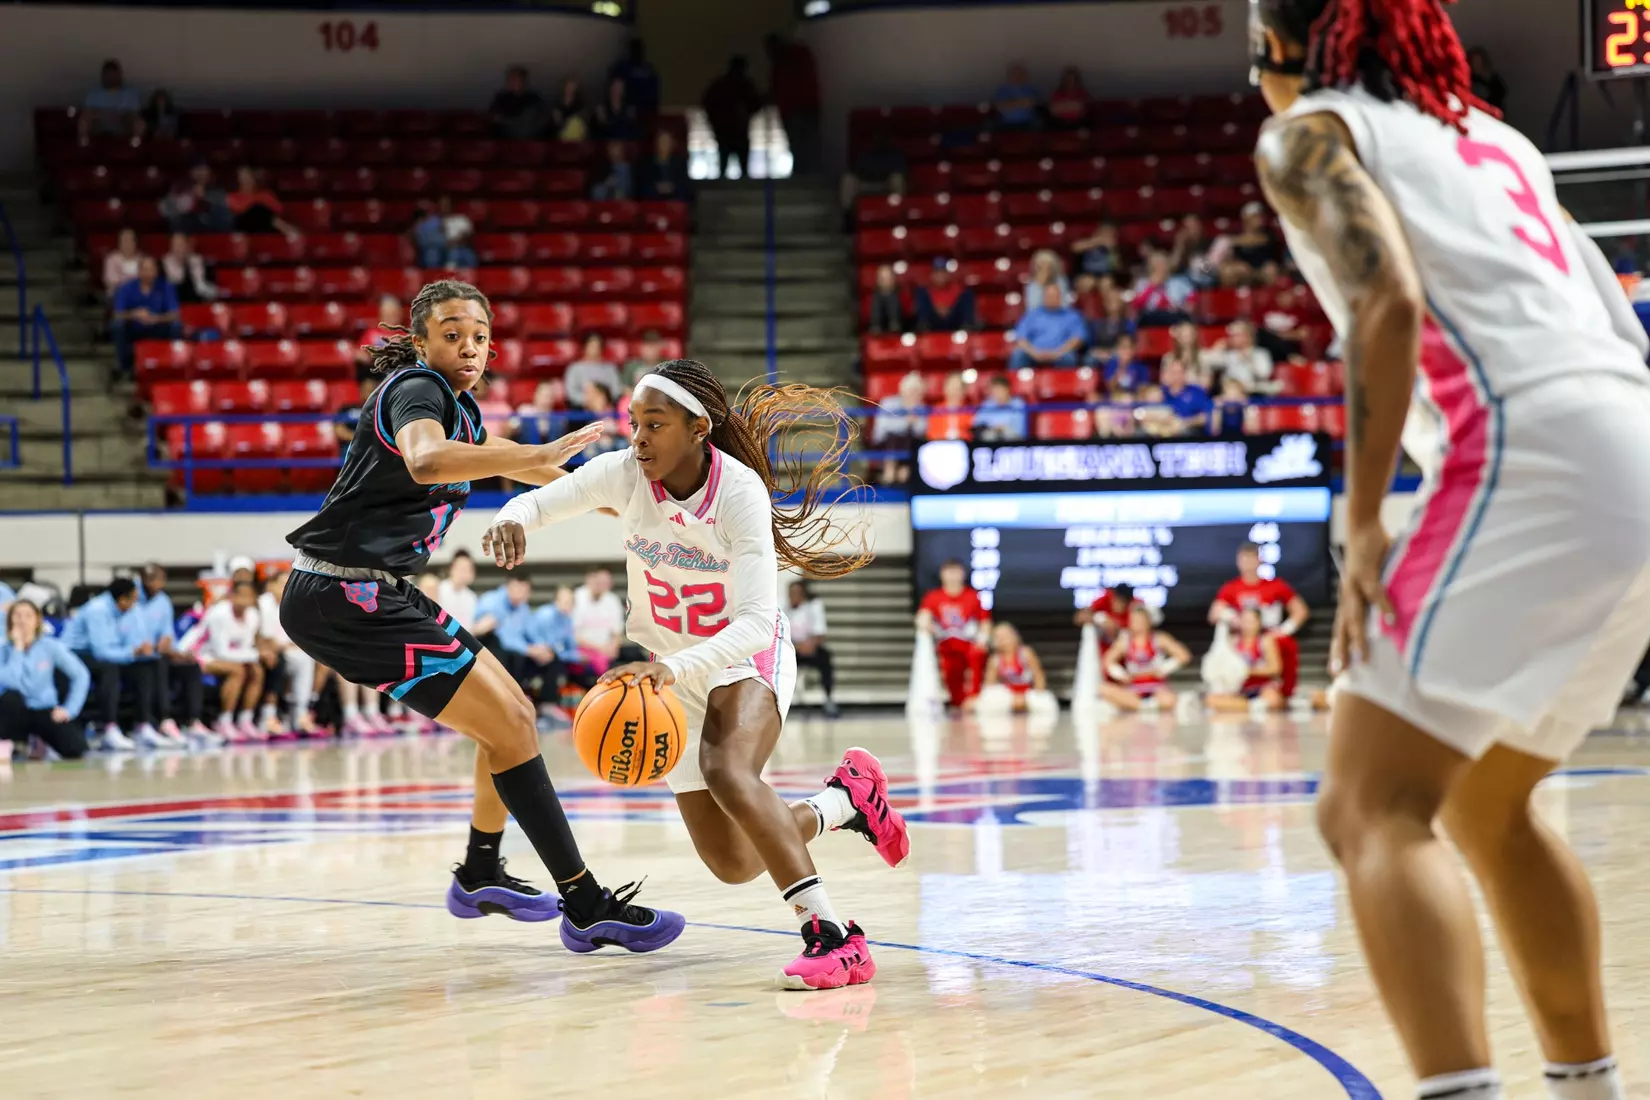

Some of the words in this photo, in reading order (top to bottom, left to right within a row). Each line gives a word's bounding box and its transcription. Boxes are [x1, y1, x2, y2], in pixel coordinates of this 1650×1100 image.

[317, 20, 380, 52] 104
[1160, 6, 1224, 40] 105
[1456, 135, 1570, 277] 3
[624, 534, 662, 570] Lady
[643, 570, 731, 637] 22
[609, 720, 640, 785] Wilson
[648, 732, 670, 780] NCAA
